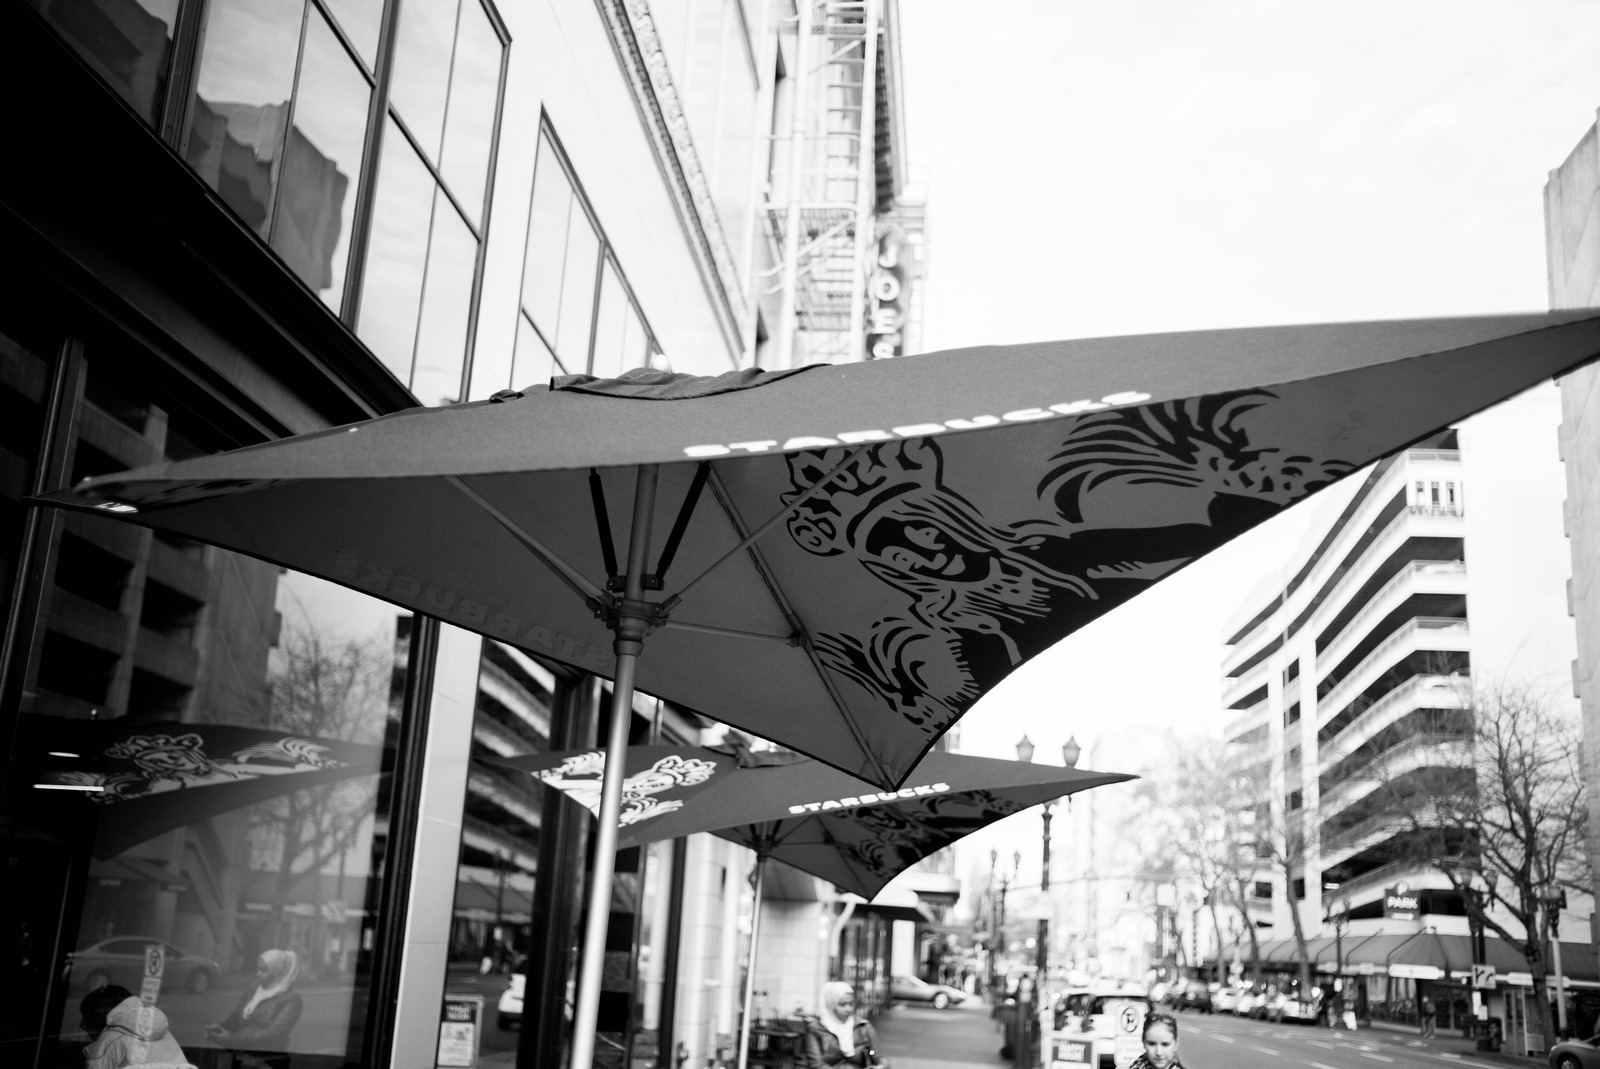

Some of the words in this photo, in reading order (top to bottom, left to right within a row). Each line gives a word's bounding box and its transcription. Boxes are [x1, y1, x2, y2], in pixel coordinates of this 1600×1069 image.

[684, 391, 1151, 457] STARBUCKS
[789, 783, 949, 813] STARBUCKS
[1387, 895, 1418, 910] PARK
